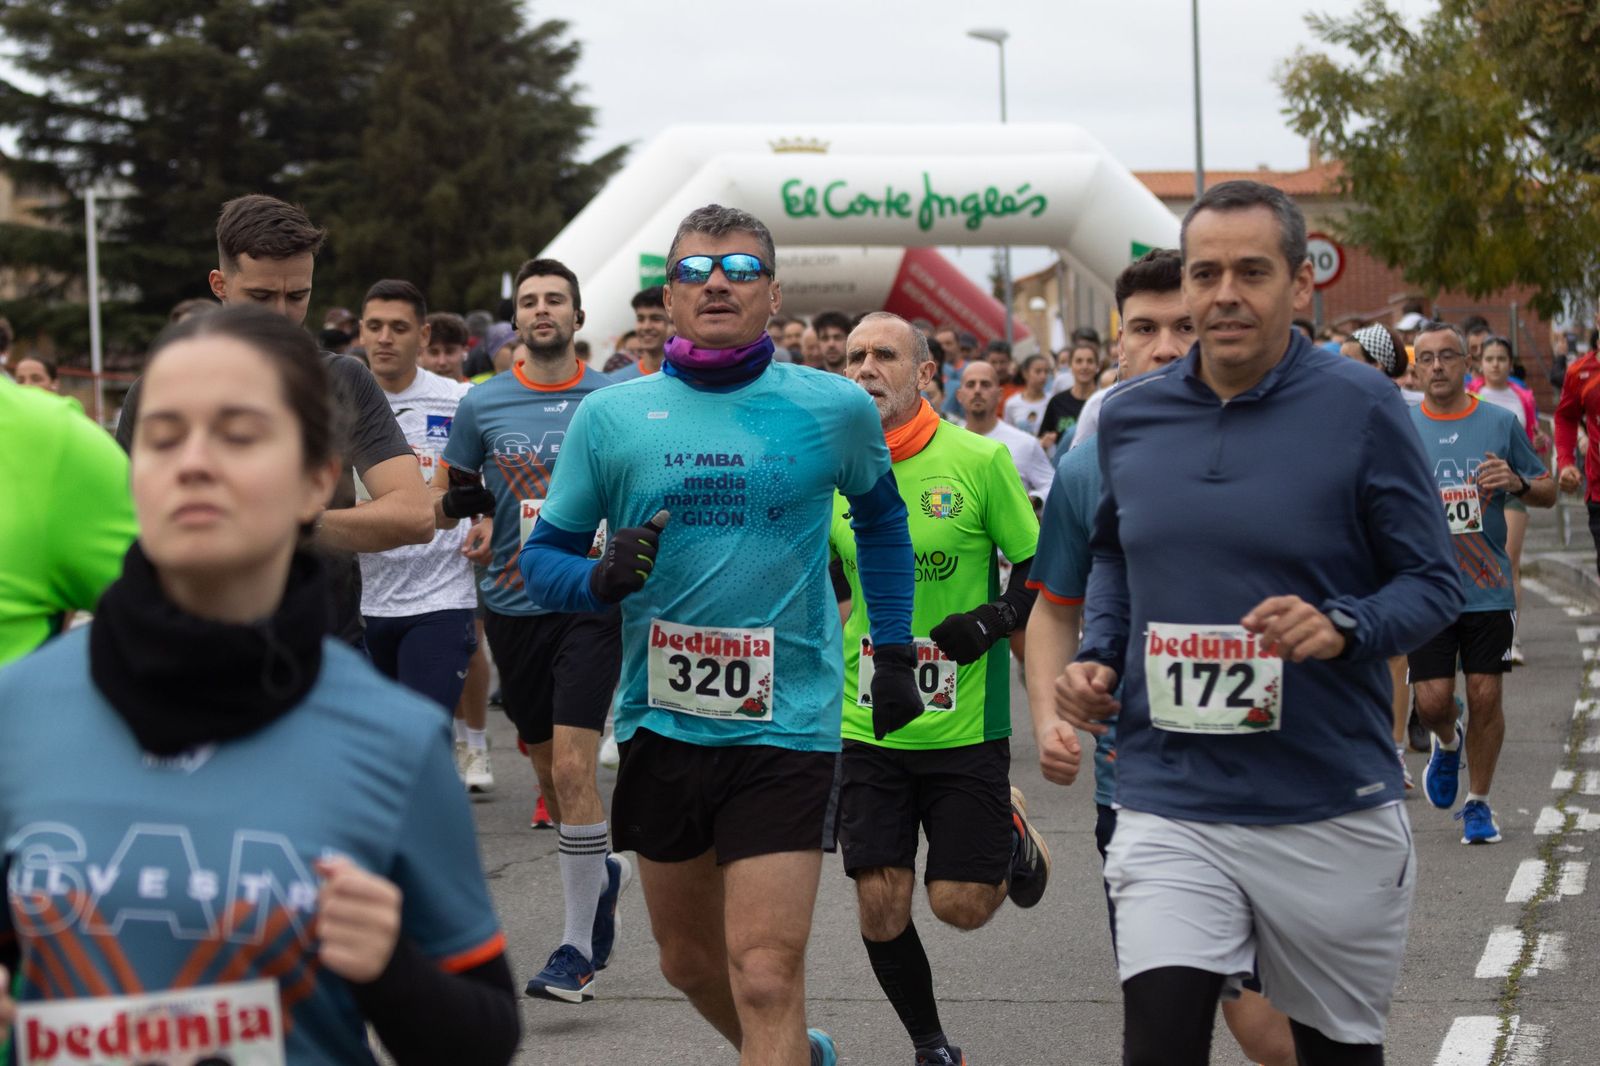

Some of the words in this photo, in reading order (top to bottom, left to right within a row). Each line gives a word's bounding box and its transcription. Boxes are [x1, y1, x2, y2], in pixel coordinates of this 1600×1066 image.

[781, 178, 820, 218] El
[823, 180, 912, 219] Corte
[918, 171, 1048, 232] Inglés
[694, 453, 744, 466] MBA
[684, 473, 746, 489] media
[682, 506, 744, 527] GIJÓN
[651, 624, 770, 658] bedunia
[668, 654, 751, 699] 320
[1166, 661, 1256, 708] 172
[25, 1000, 273, 1063] bedunia
